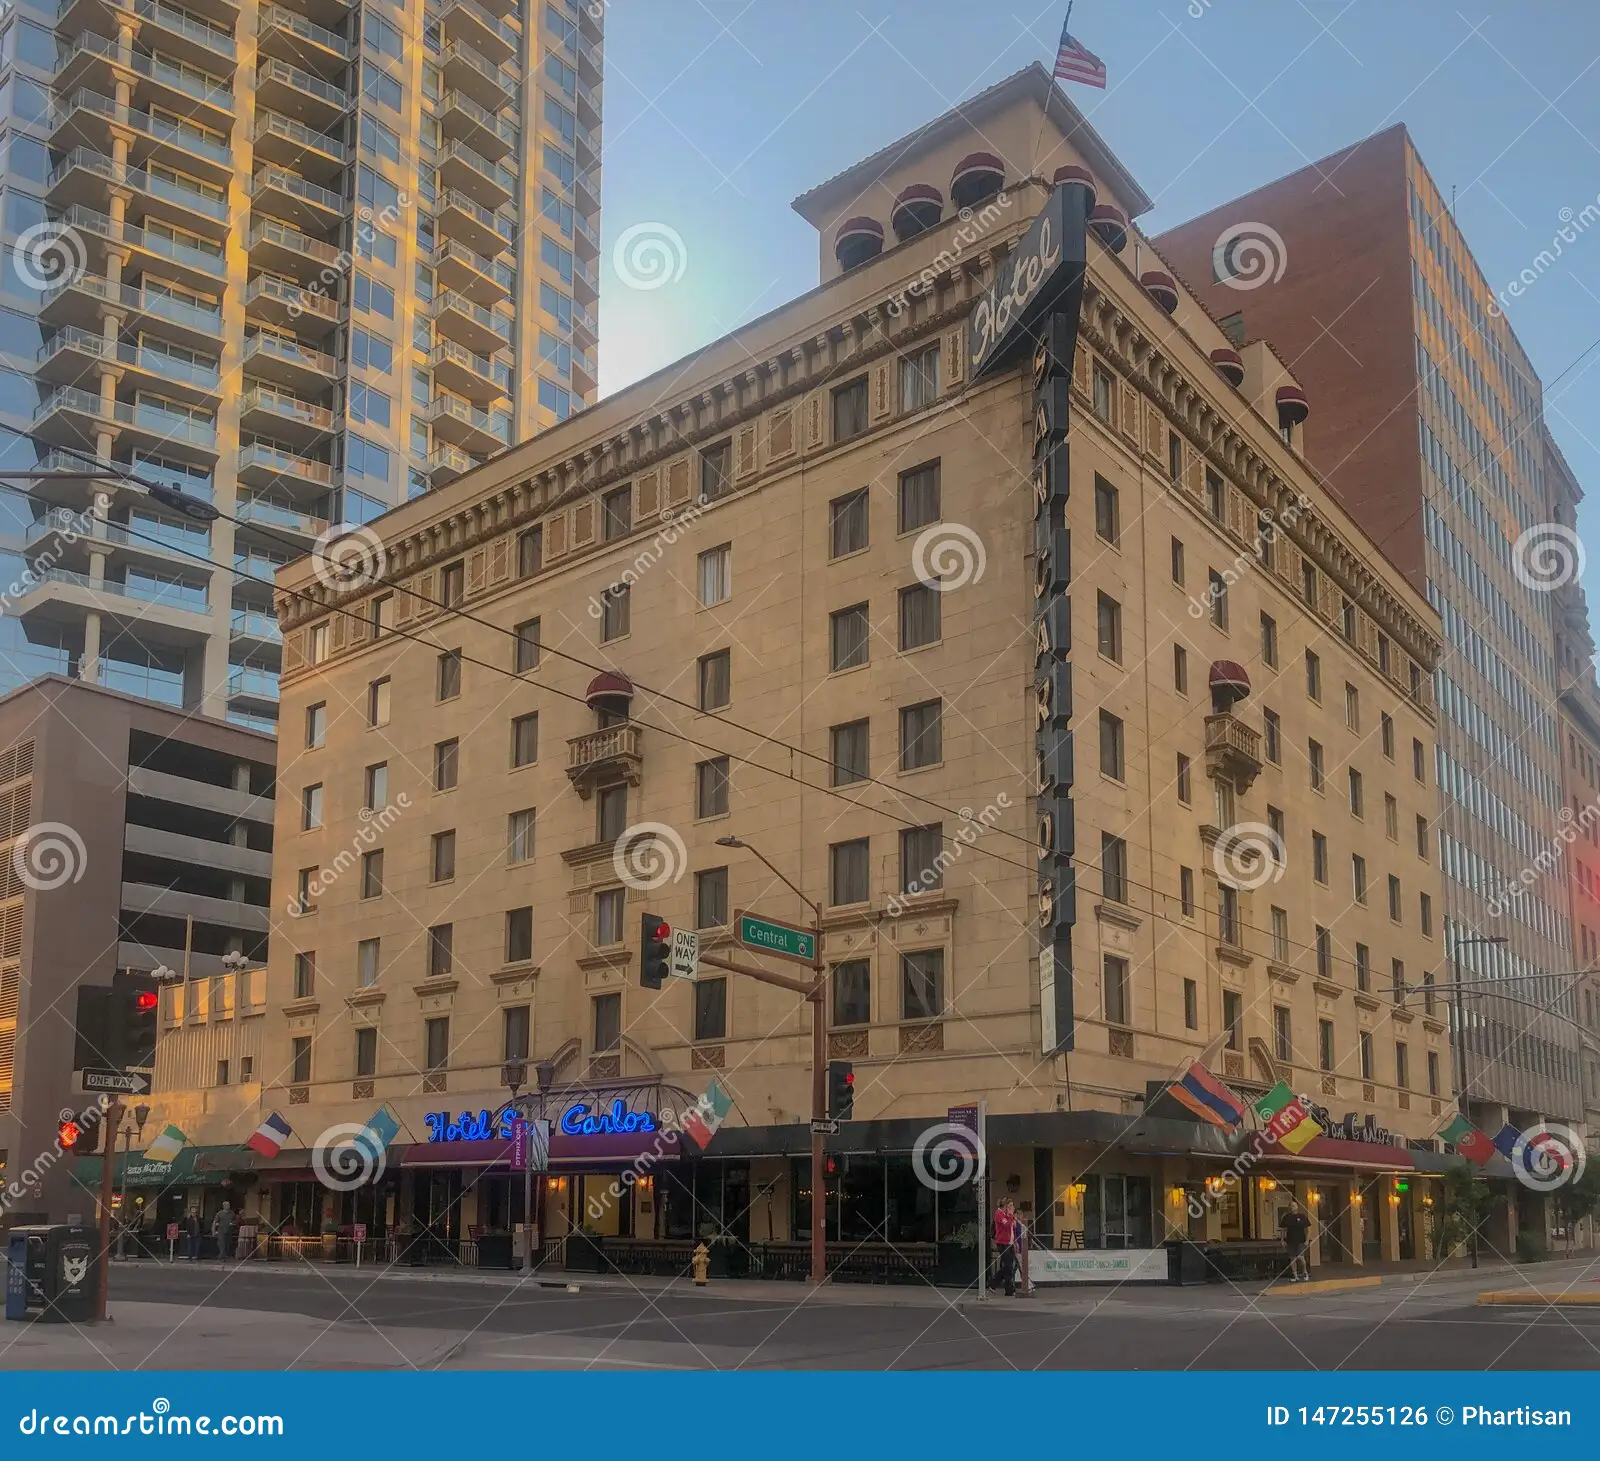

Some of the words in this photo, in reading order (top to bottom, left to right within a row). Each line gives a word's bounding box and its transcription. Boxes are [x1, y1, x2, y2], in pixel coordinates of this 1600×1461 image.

[972, 216, 1060, 366] Hotel
[676, 932, 696, 948] ONE
[749, 925, 788, 948] Central
[674, 947, 696, 961] WAY
[89, 1075, 109, 1086] ONE
[112, 1077, 133, 1087] WAY
[424, 1109, 492, 1143] Hotel
[561, 1099, 656, 1136] Carlos
[1348, 1112, 1392, 1146] Carlos
